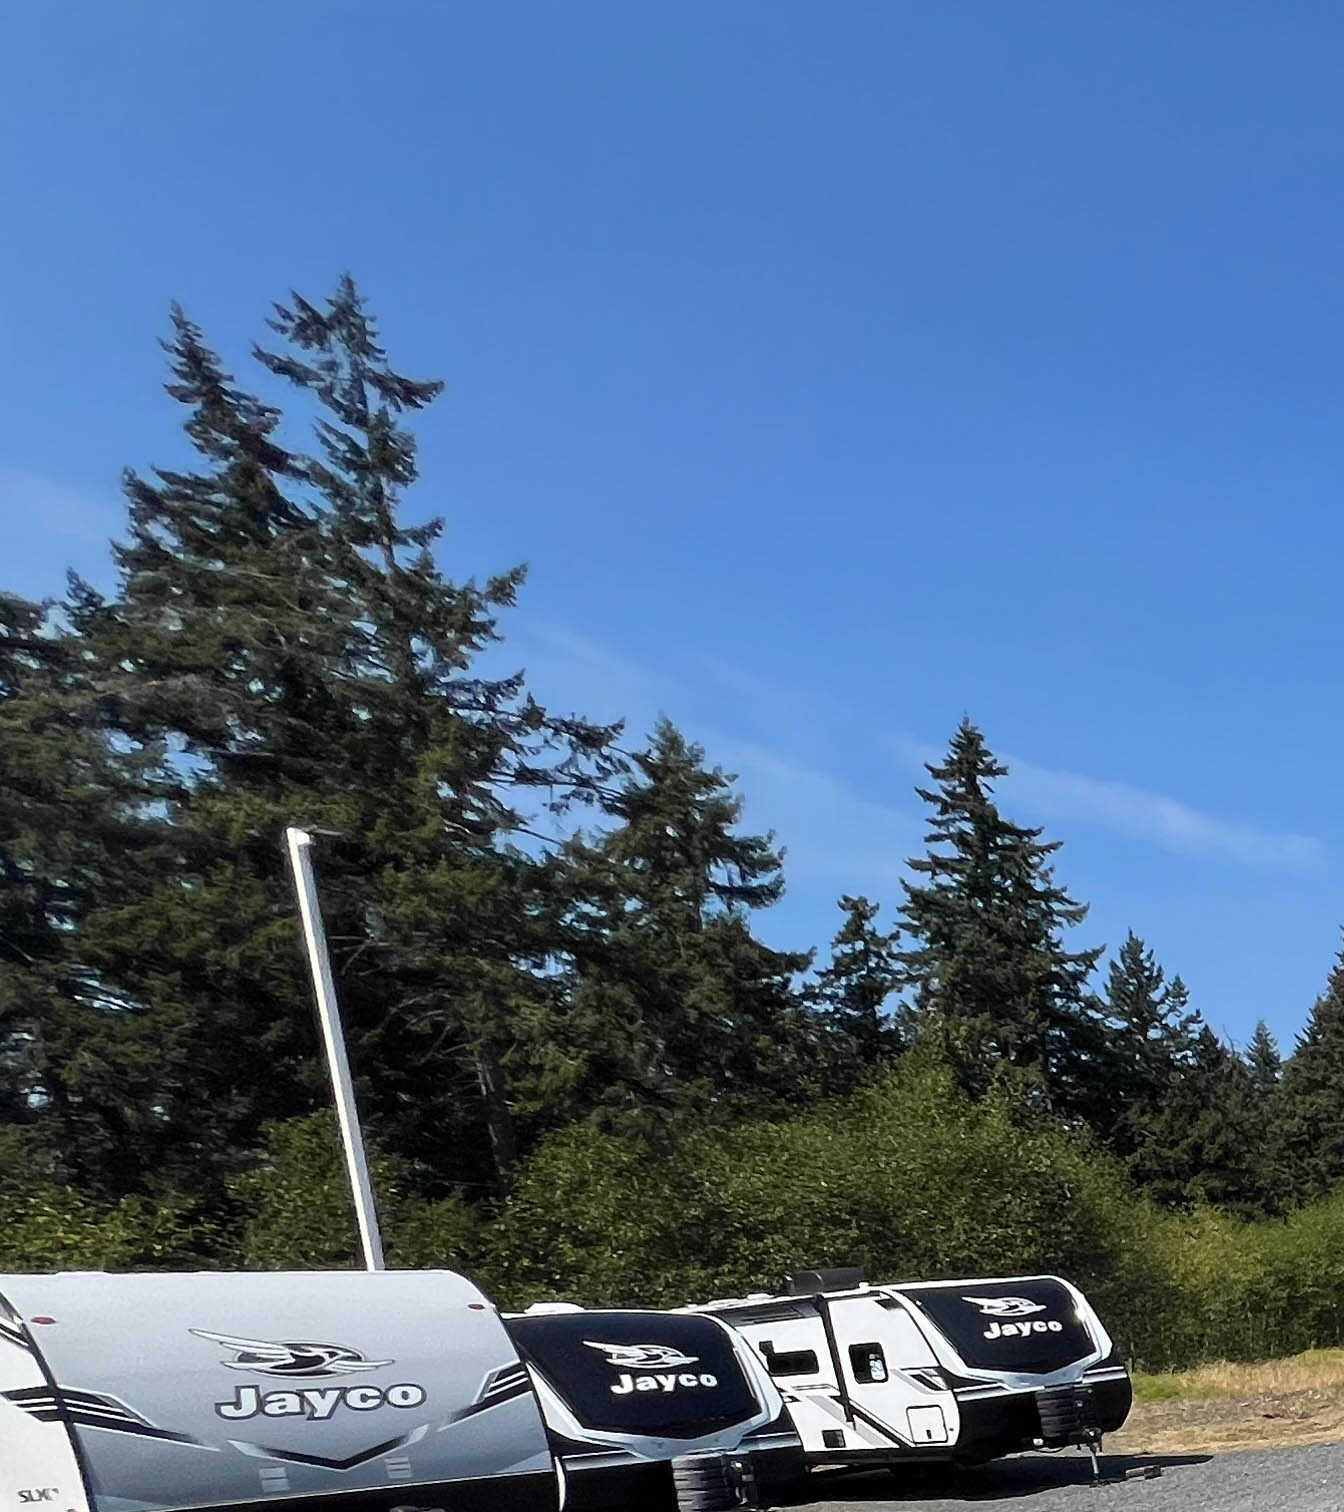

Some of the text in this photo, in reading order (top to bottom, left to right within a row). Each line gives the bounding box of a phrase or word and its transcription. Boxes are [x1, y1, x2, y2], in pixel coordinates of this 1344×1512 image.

[982, 1320, 1064, 1340] Jayco
[610, 1373, 719, 1395] Jayco
[214, 1382, 427, 1421] Jayco
